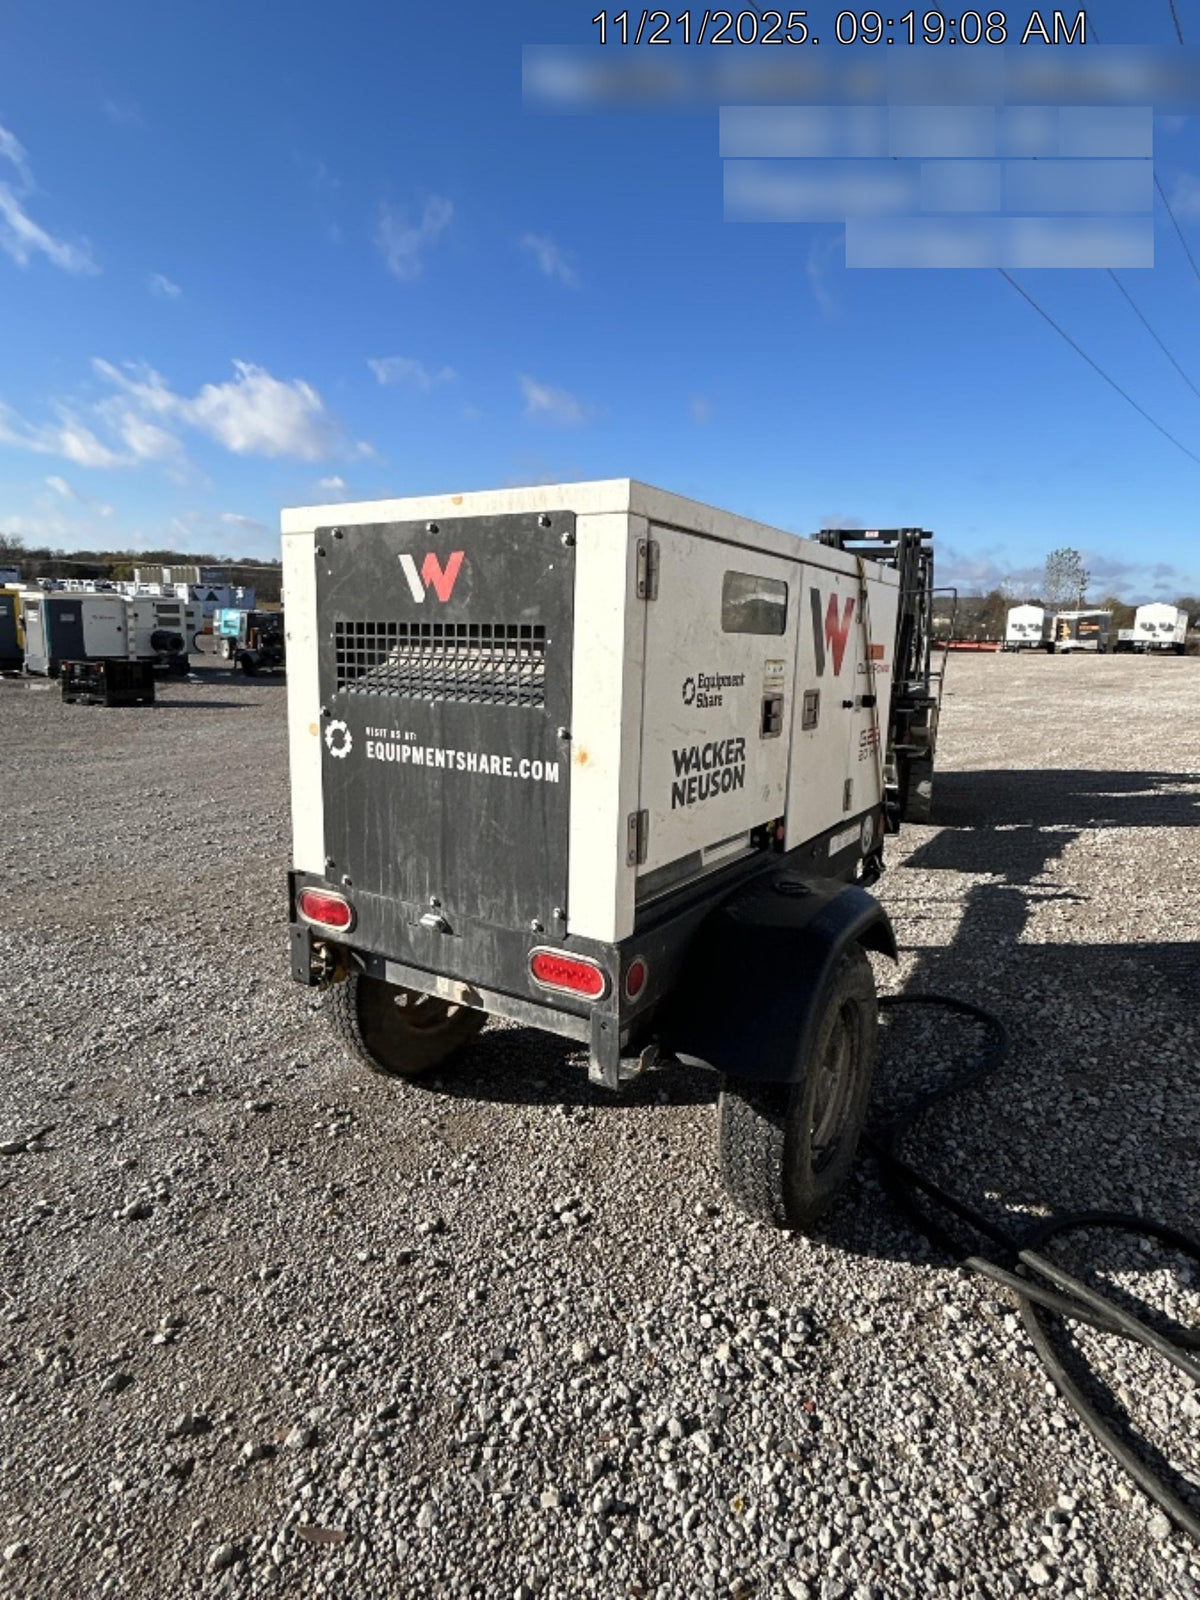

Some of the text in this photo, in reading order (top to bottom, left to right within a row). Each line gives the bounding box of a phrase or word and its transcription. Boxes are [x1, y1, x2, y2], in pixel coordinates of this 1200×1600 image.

[697, 672, 746, 692] Equipment
[696, 693, 723, 708] Share
[365, 726, 388, 739] VISIT
[390, 730, 401, 739] US
[366, 741, 560, 783] EQUIPMENTSHARE.COM
[672, 738, 746, 777] WACKER
[671, 764, 746, 810] NEUSON
